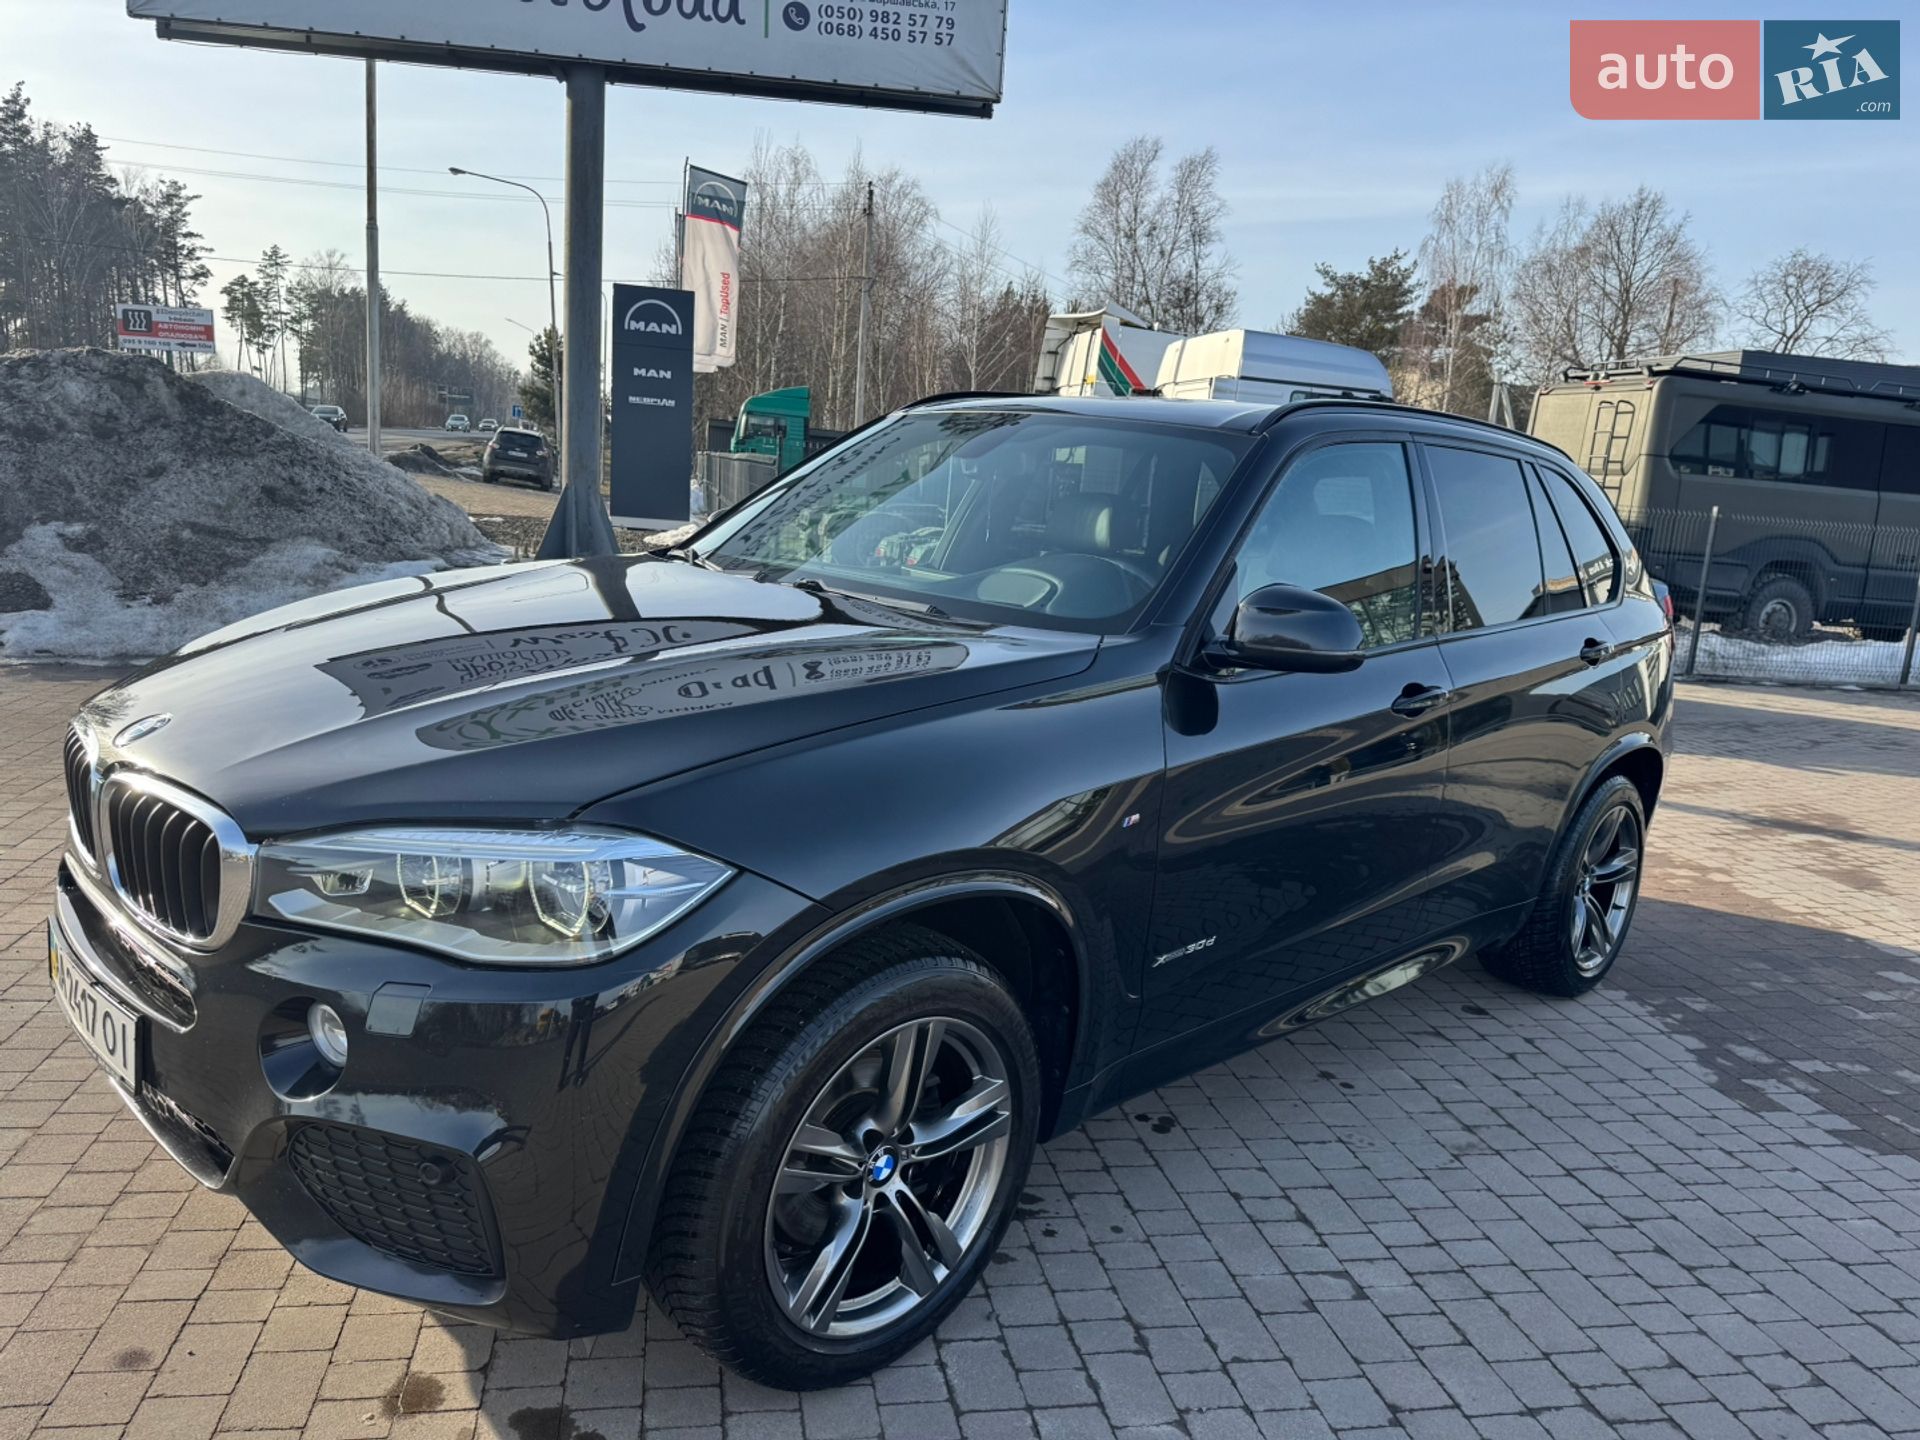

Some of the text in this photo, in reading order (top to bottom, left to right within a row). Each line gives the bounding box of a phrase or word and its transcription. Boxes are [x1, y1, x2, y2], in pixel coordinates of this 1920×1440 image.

[818, 4, 955, 30] (050) 982 57 79
[868, 0, 956, 12] аршавська, 17
[817, 20, 955, 47] (068) 450 57 57
[697, 195, 735, 217] MAN
[629, 320, 677, 335] MAN
[719, 323, 728, 348] MAN
[633, 367, 672, 379] MAN
